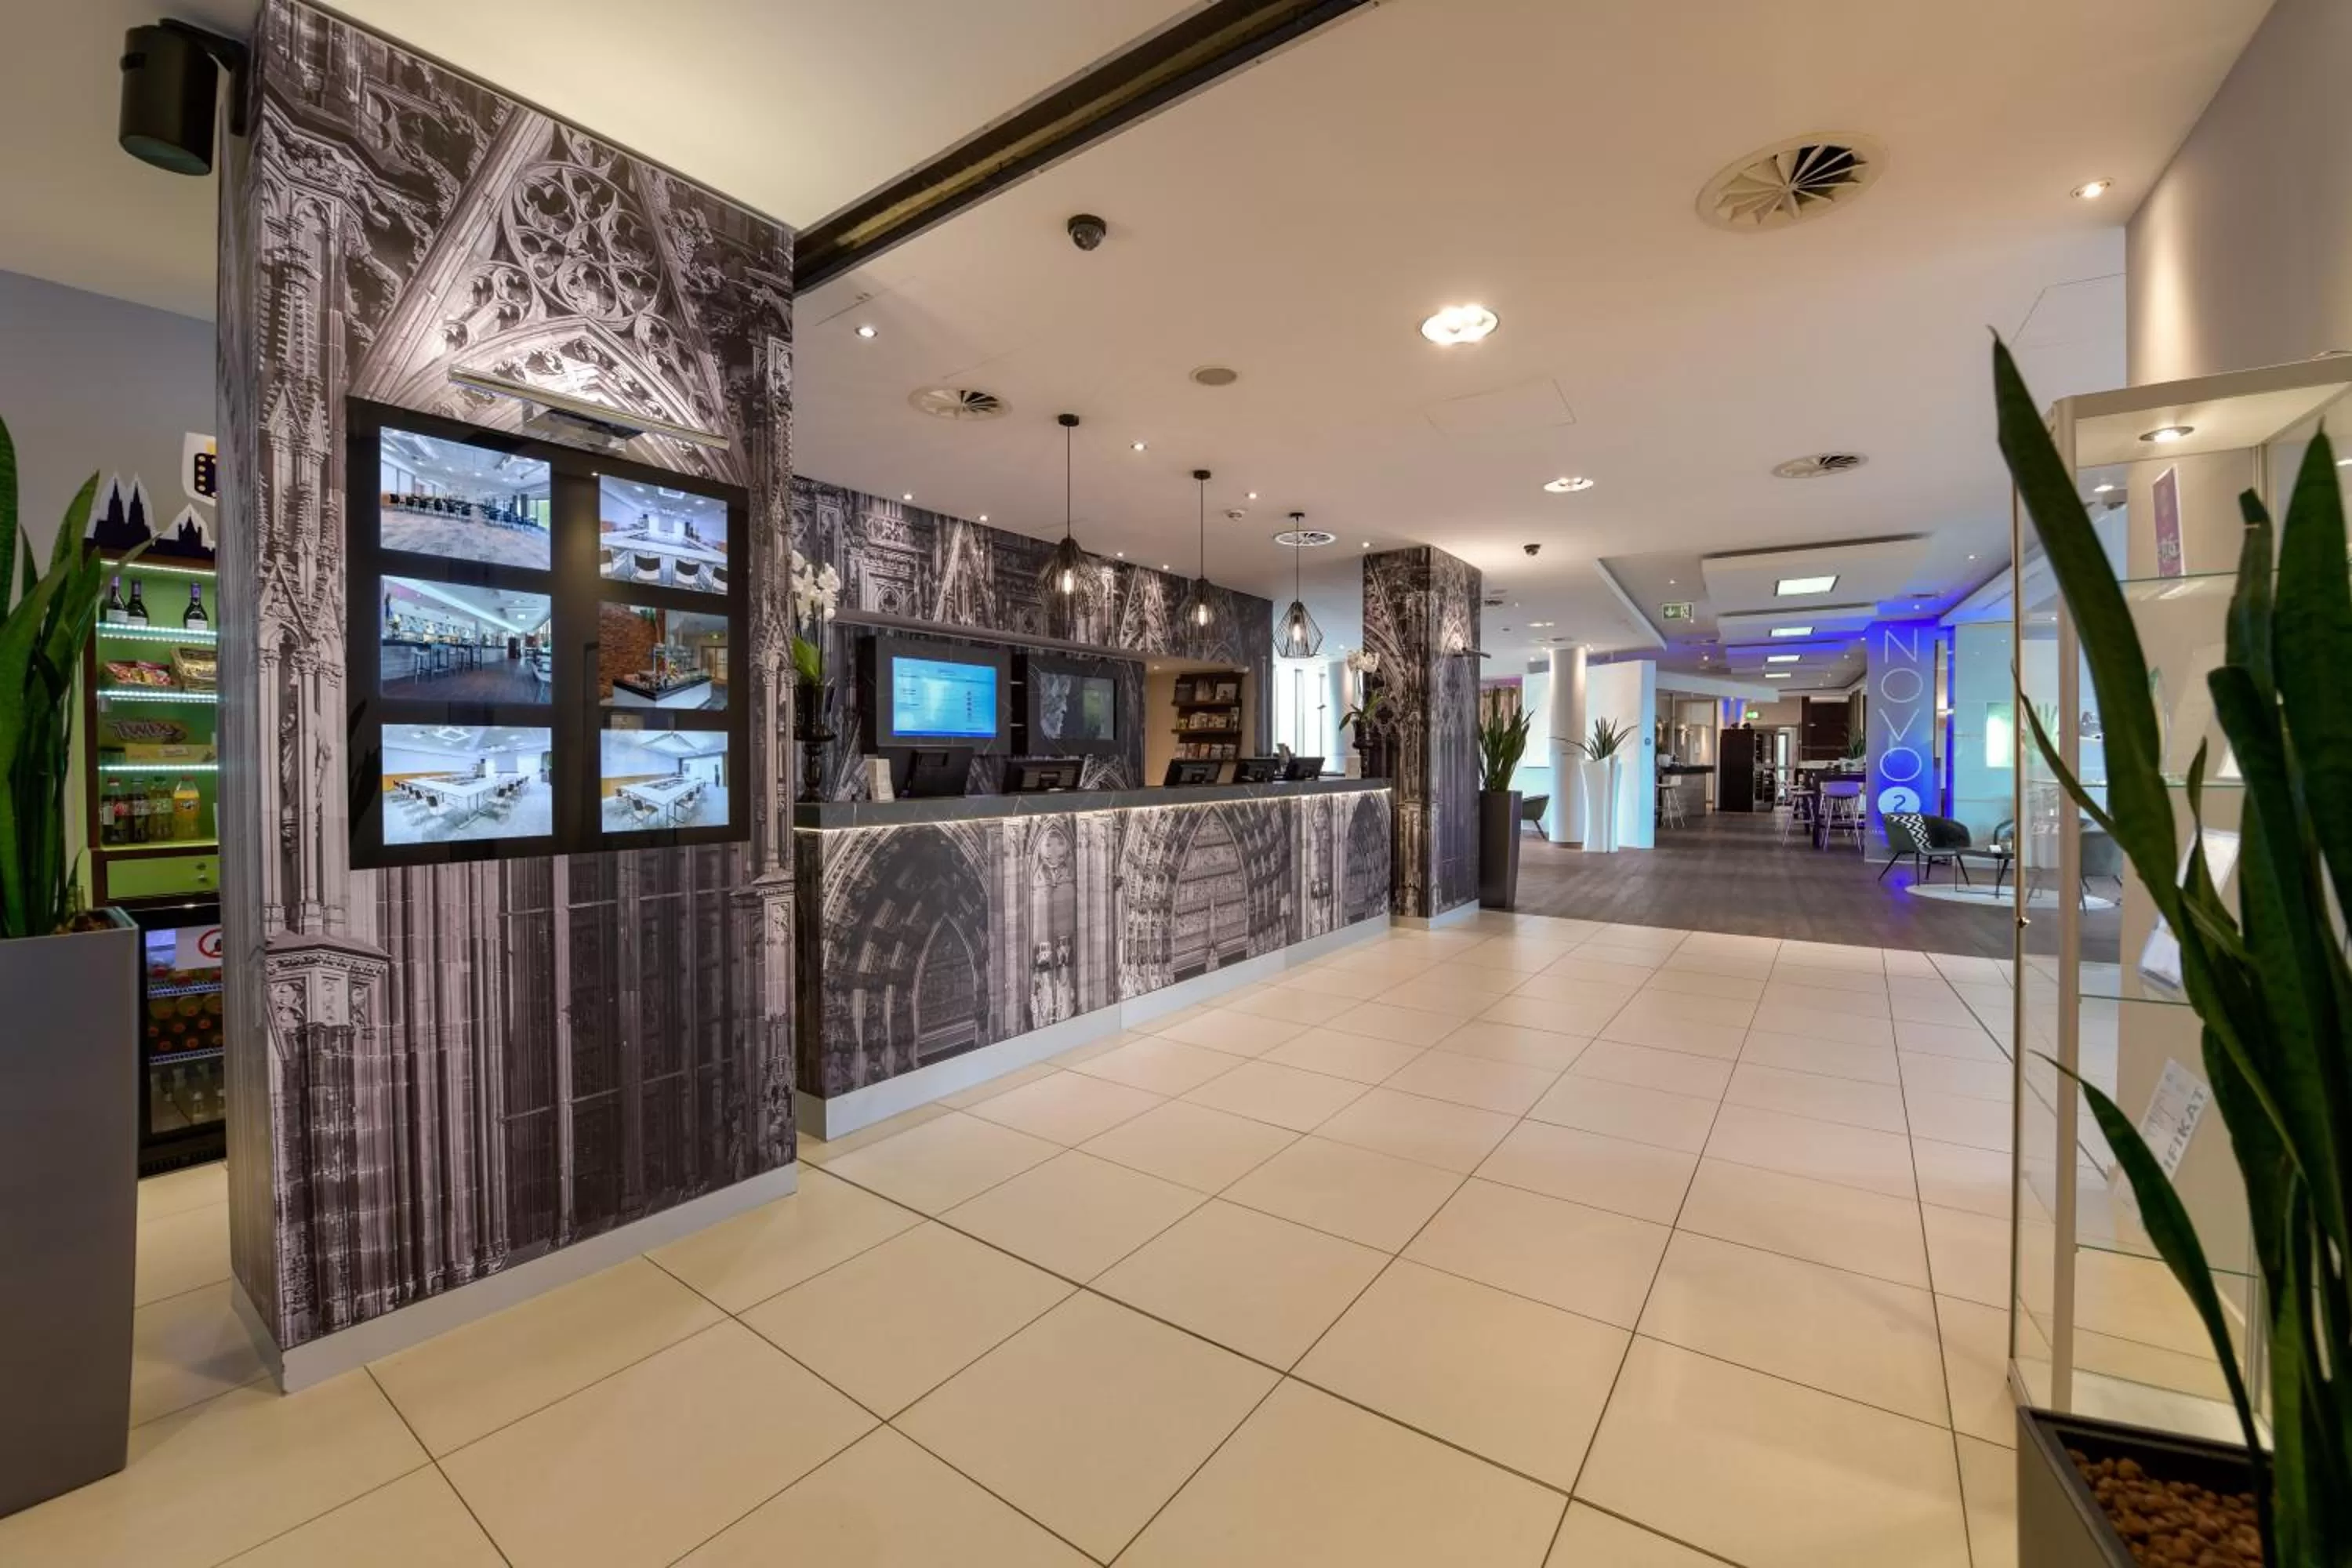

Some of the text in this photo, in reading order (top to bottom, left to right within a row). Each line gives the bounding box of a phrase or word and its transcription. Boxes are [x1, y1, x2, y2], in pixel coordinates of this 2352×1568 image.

[1879, 628, 1923, 812] NOVO 2
[2162, 1087, 2205, 1171] IFIKAT
